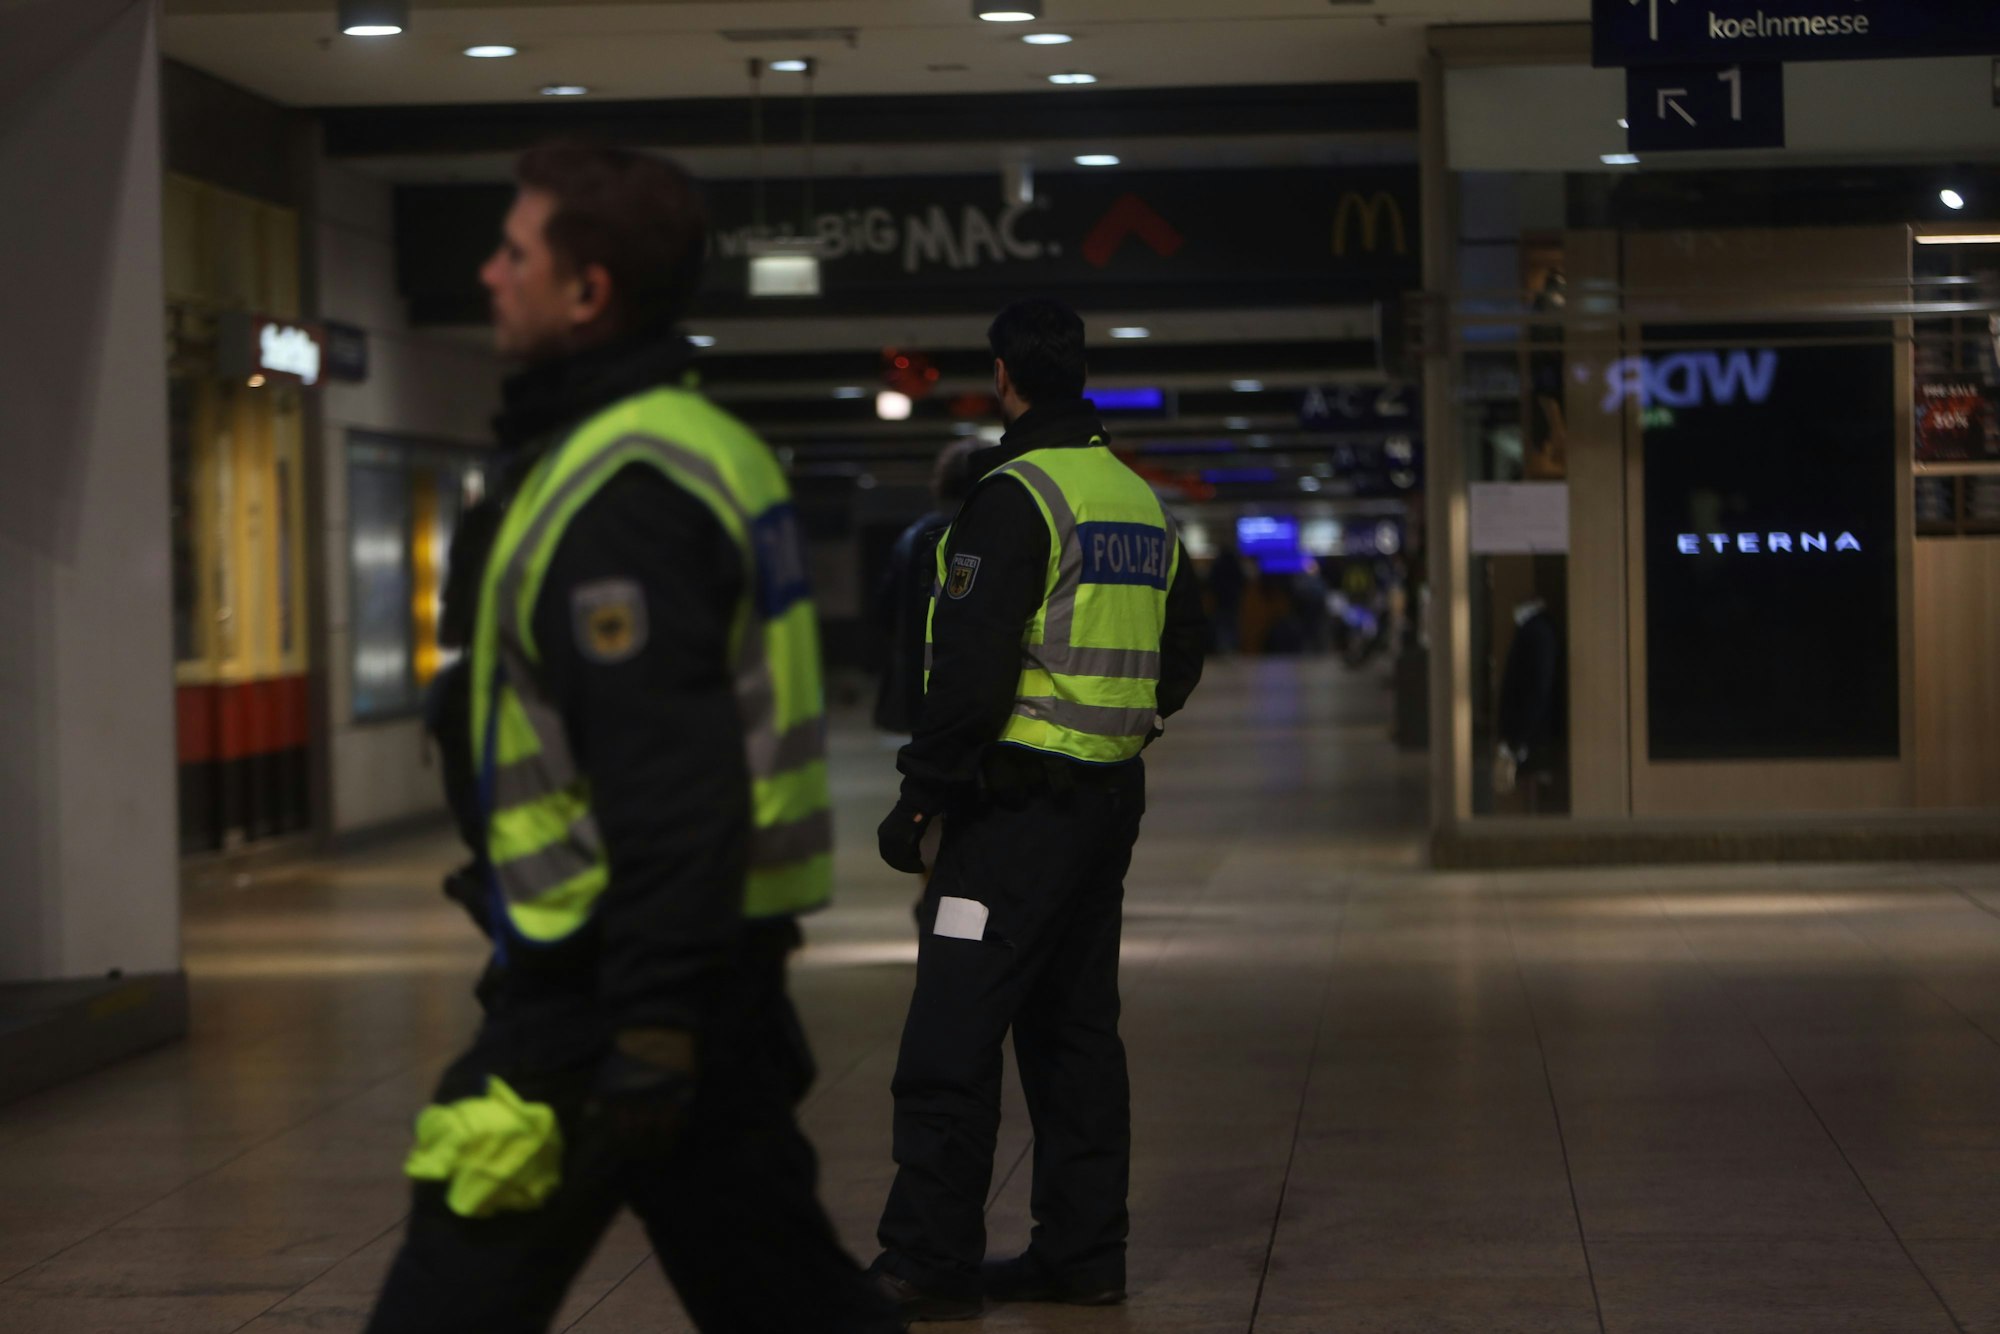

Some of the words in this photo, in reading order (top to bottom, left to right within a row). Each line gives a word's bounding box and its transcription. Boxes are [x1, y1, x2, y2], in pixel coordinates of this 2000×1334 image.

[1707, 11, 1869, 40] koelnmesse
[1717, 66, 1742, 121] 1
[1093, 533, 1166, 579] POLIZEI
[1676, 530, 1862, 555] ETERNA
[954, 556, 977, 569] POLIZEI
